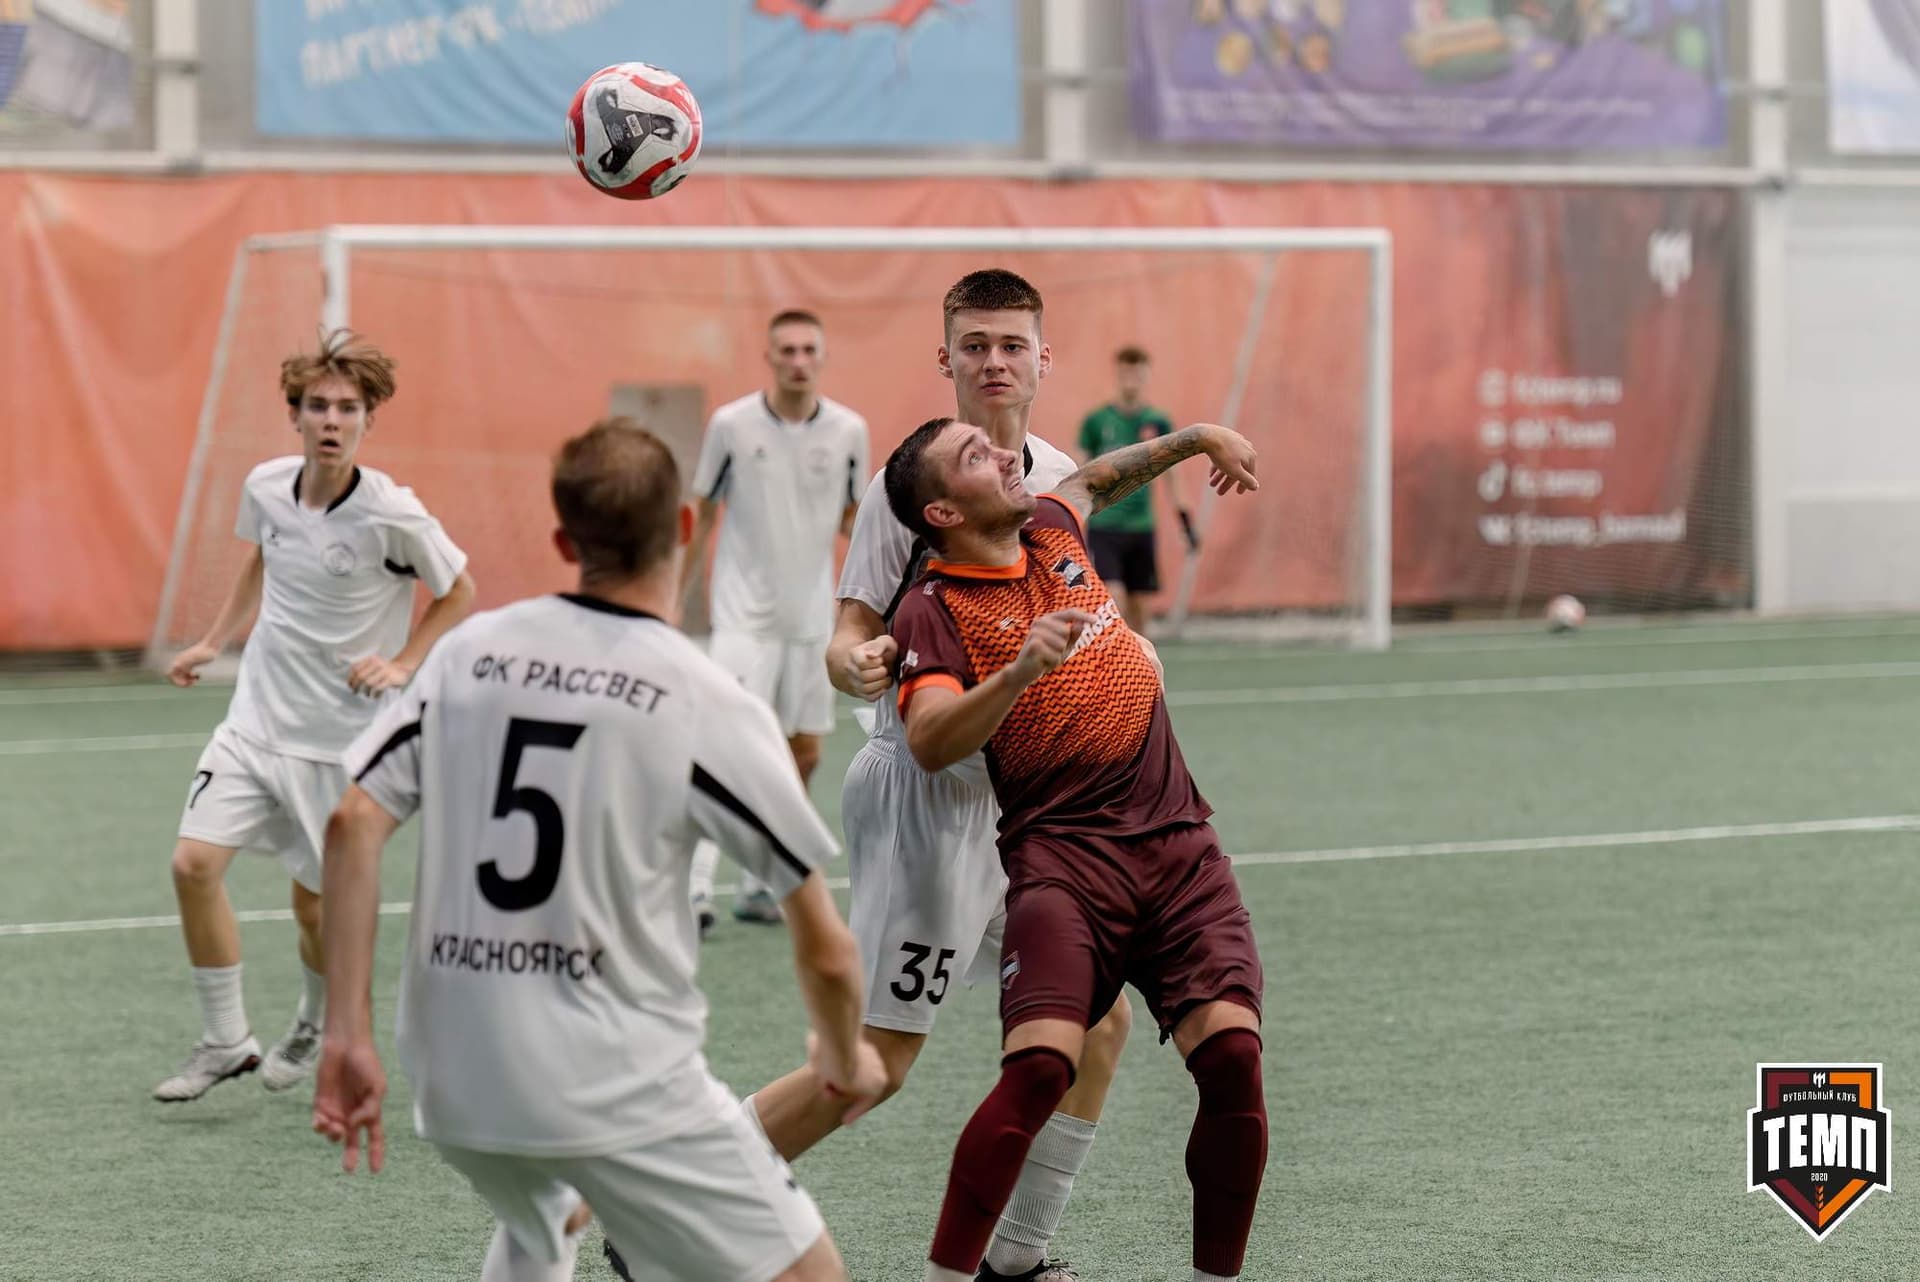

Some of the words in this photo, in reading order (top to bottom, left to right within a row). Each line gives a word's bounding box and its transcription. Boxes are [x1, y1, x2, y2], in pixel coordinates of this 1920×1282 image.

[472, 655, 515, 682] ФК
[523, 660, 669, 714] РАССВЕТ
[477, 716, 588, 912] 5
[431, 934, 604, 981] КРАСНОЯРСК
[890, 941, 956, 1005] 35
